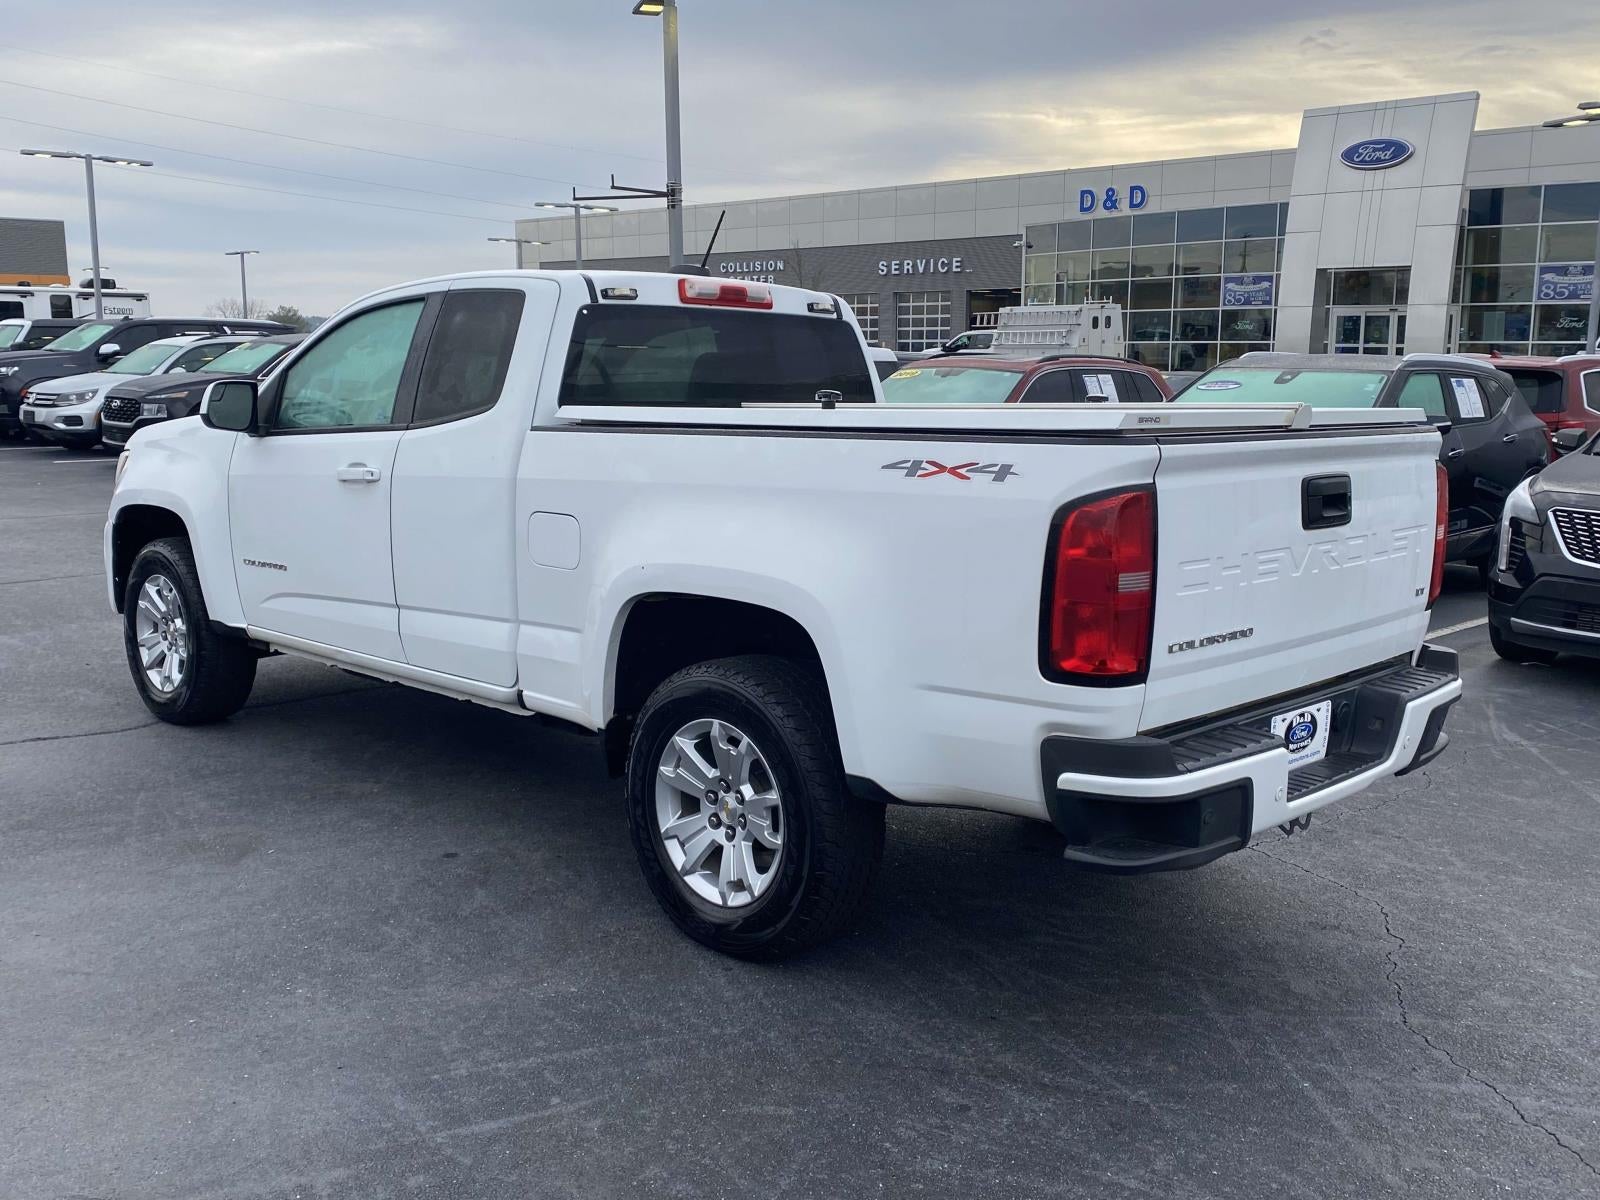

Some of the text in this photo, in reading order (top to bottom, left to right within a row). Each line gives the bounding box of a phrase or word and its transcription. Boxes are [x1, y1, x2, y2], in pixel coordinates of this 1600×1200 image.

[1353, 143, 1396, 162] Ford
[1079, 184, 1148, 213] D & D
[720, 260, 785, 273] COLLISION
[878, 257, 962, 275] SERVICE
[1556, 317, 1586, 328] Ford
[243, 558, 288, 571] COLORADO
[1175, 523, 1429, 597] CHEVROLET
[1167, 627, 1254, 654] COLORADO
